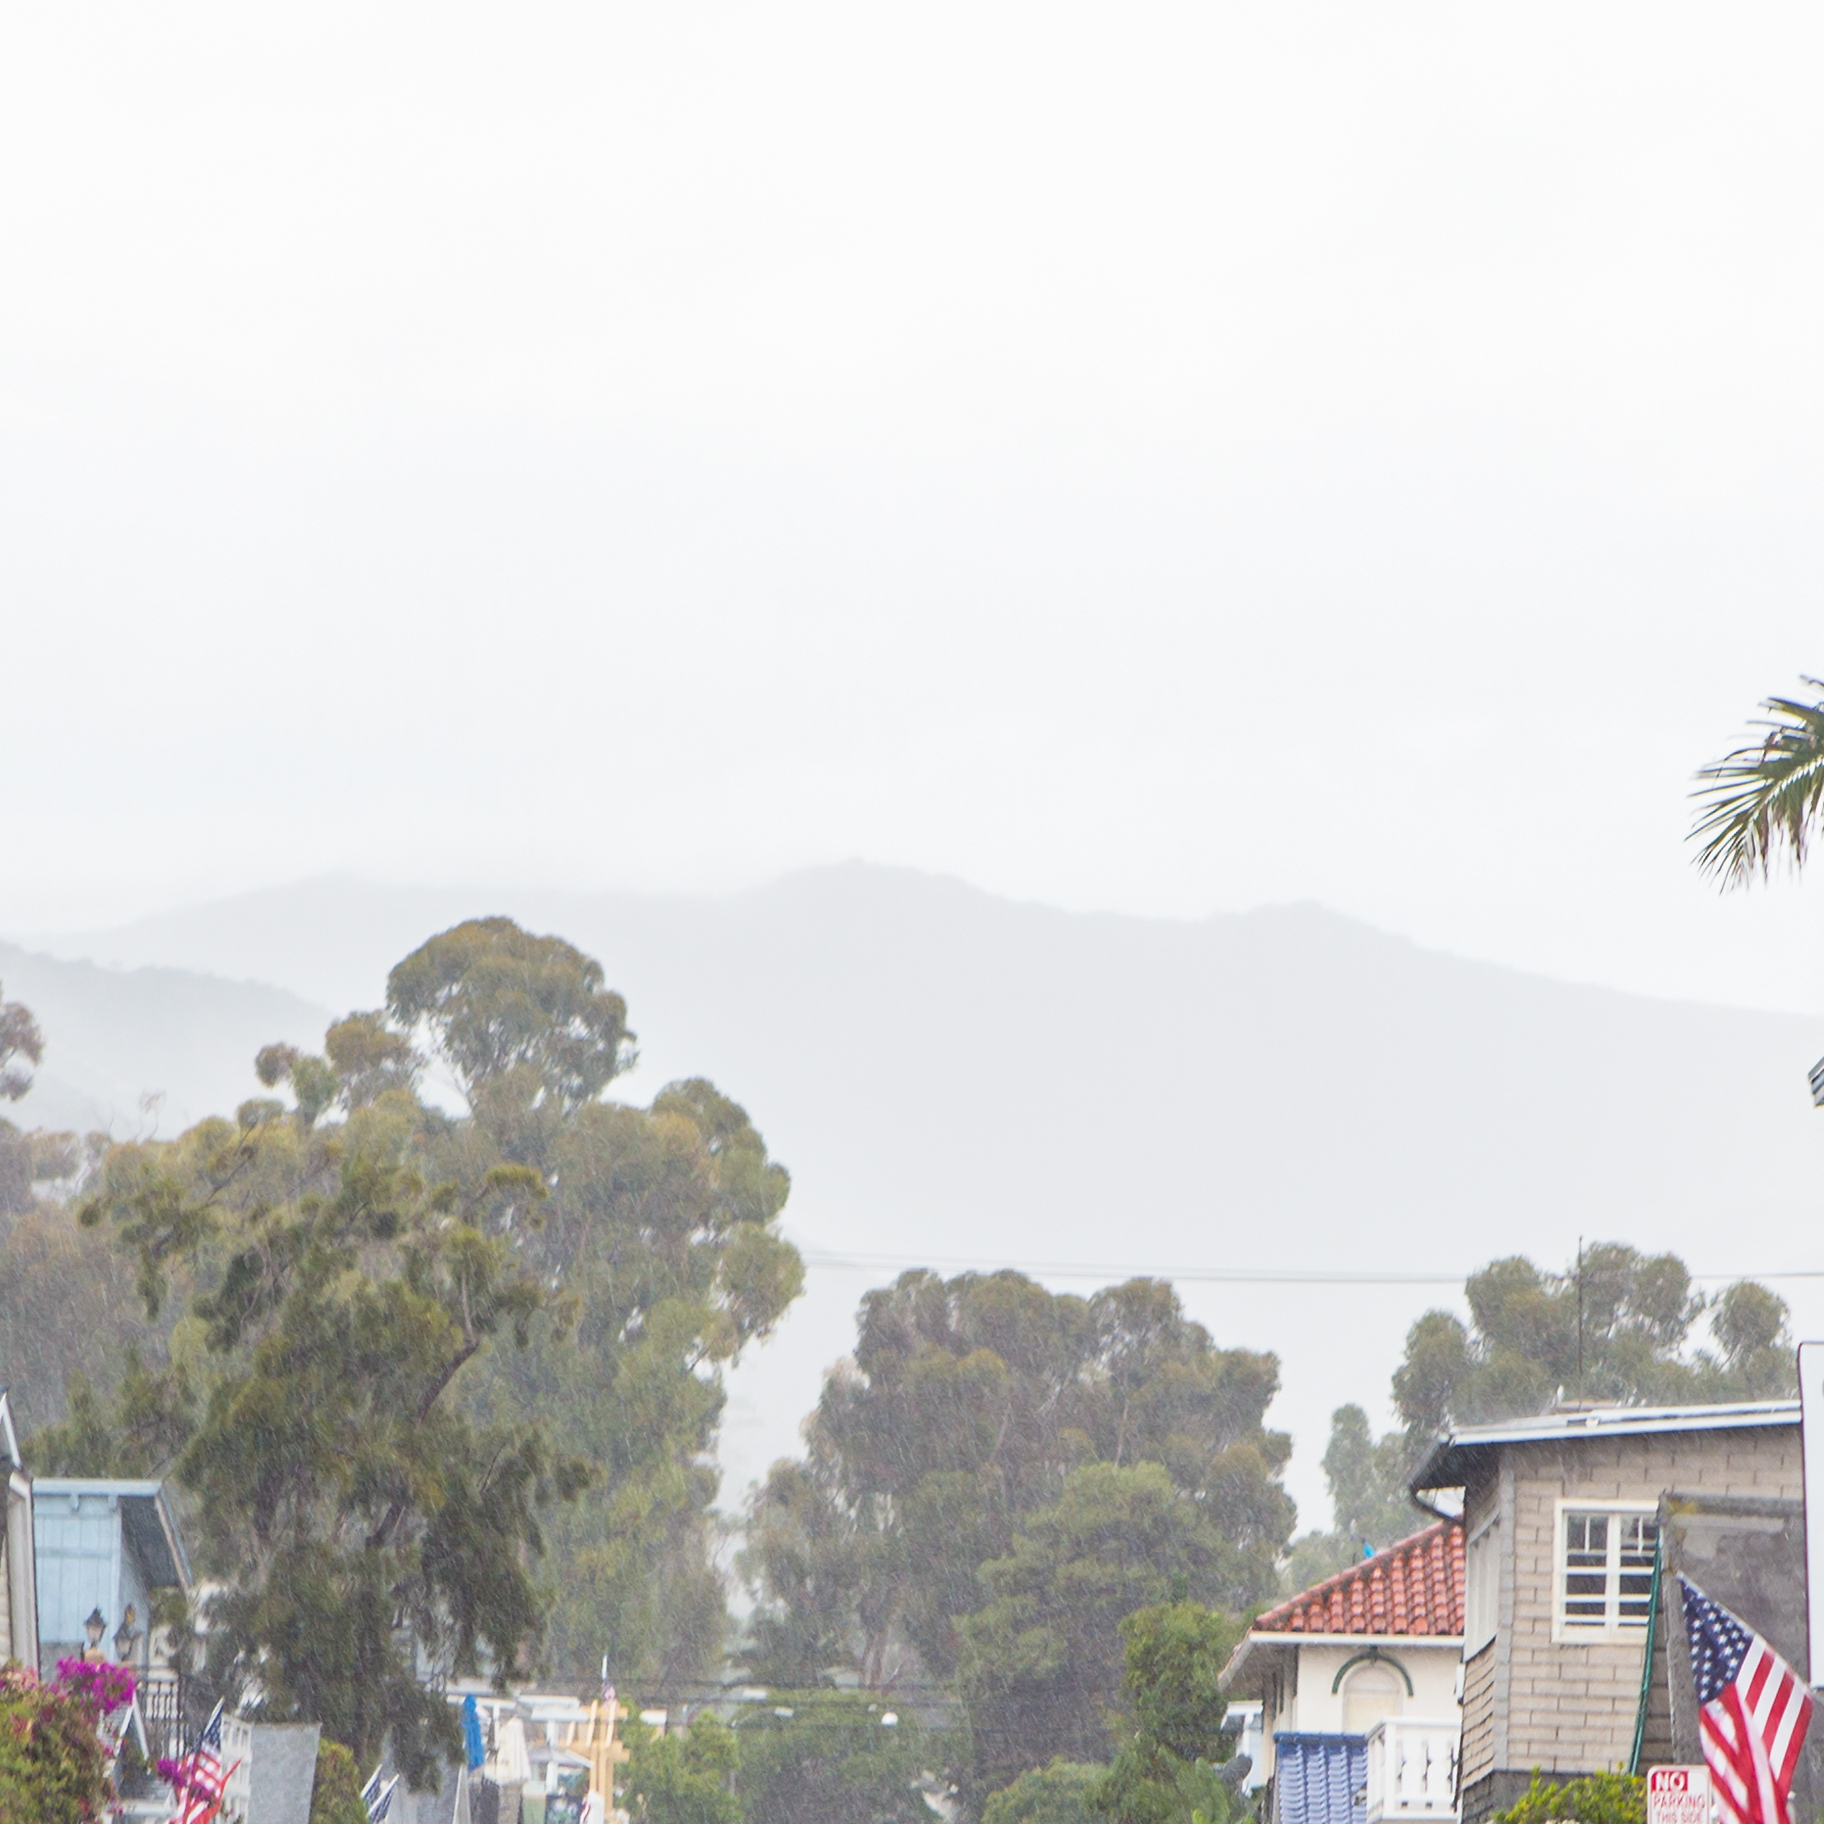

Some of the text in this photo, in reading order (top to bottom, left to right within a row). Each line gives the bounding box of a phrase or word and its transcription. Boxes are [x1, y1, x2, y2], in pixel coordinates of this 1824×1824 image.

[1655, 1771, 1685, 1791] NO
[1654, 1793, 1706, 1809] PARKING
[1656, 1810, 1703, 1824] THIS SIDE
